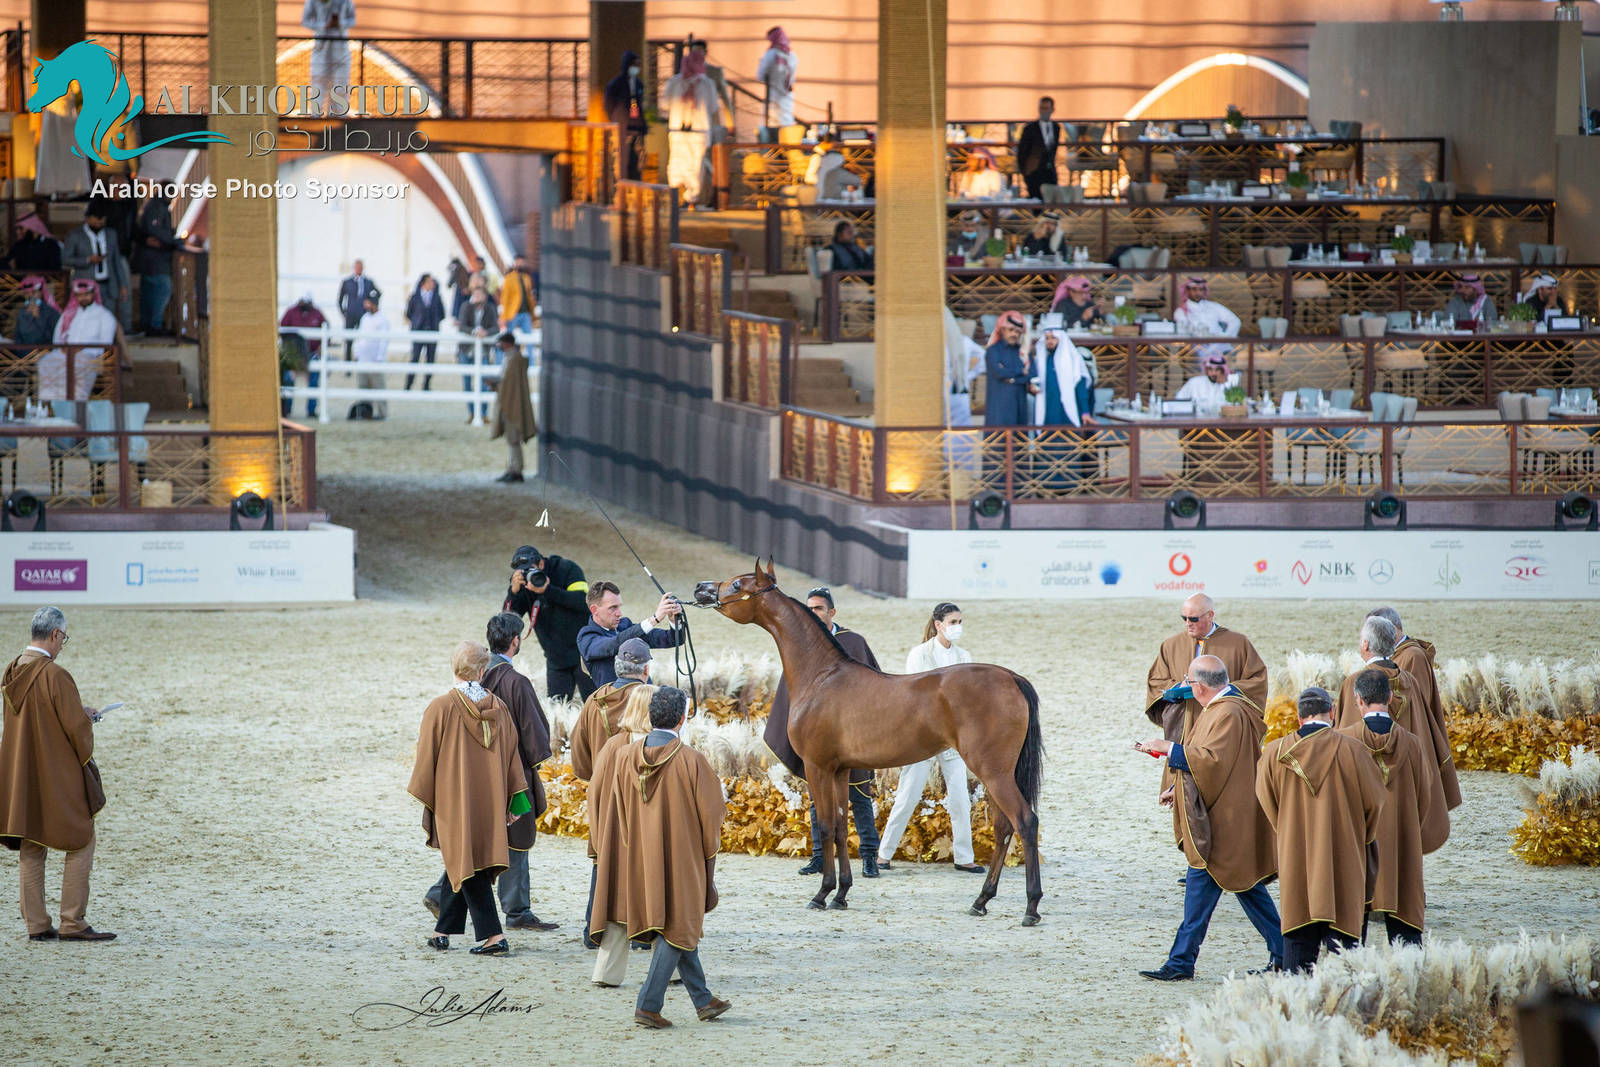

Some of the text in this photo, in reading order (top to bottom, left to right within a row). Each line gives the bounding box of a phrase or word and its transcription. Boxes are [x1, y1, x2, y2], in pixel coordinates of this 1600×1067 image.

[21, 568, 62, 581] QATAR
[1319, 561, 1356, 576] NBK
[1504, 564, 1548, 582] QIC
[1154, 580, 1206, 591] vodafone
